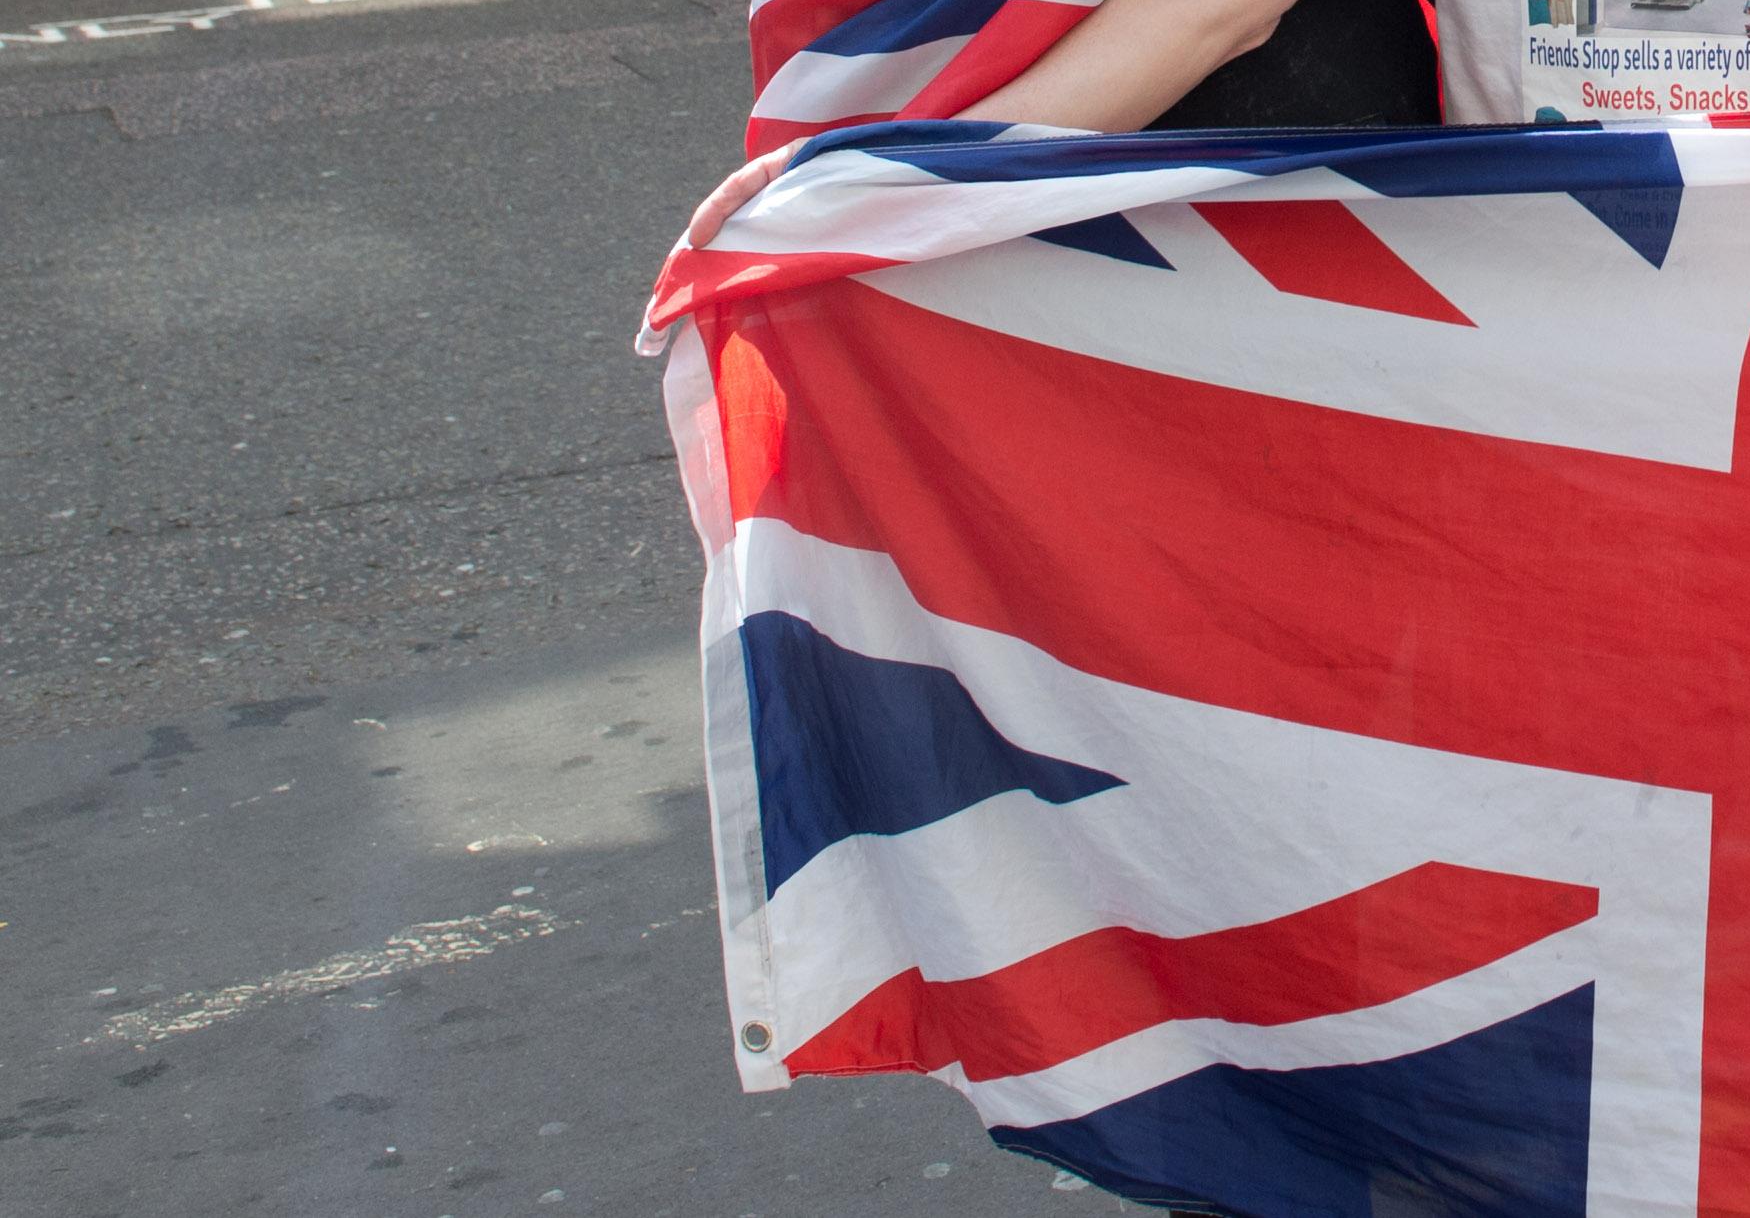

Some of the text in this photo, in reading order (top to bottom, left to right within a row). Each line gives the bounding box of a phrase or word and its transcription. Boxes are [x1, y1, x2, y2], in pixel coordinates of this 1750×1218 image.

[1529, 36, 1579, 68] Friends
[1582, 39, 1620, 78] Shop
[1623, 39, 1660, 71] sells
[1664, 48, 1673, 71] a
[1677, 40, 1732, 79] variety
[1582, 81, 1662, 115] Sweets,
